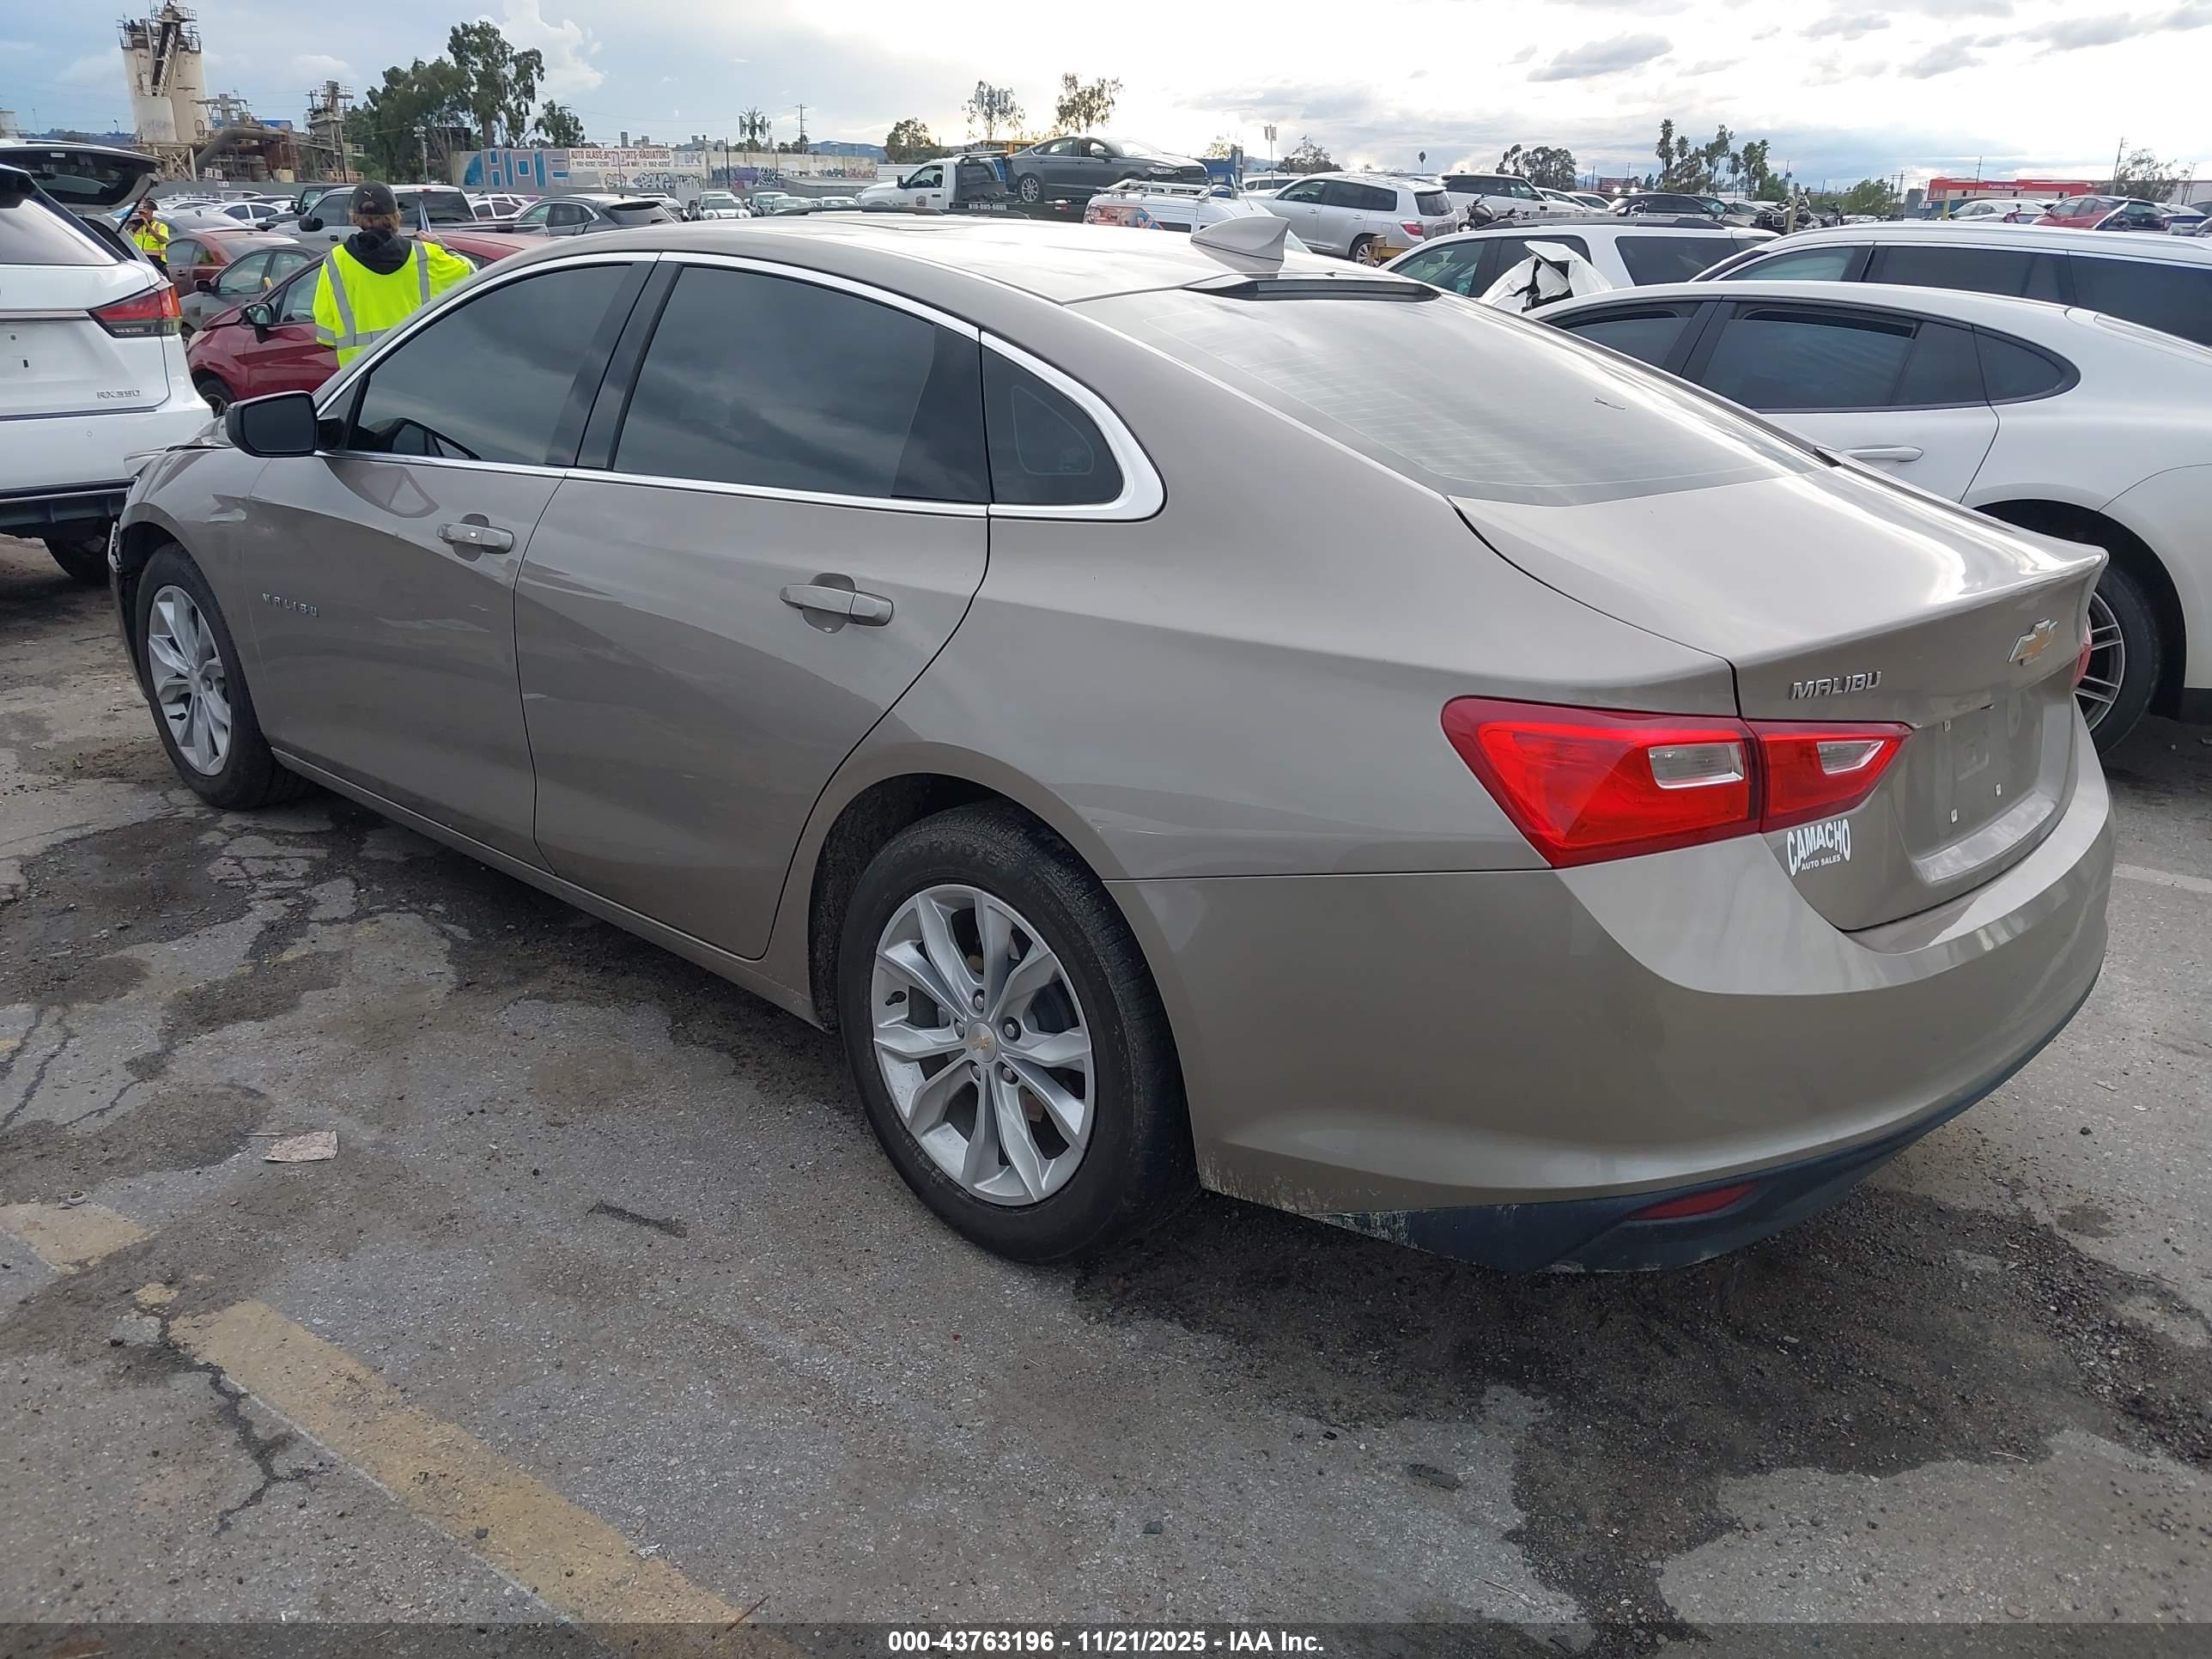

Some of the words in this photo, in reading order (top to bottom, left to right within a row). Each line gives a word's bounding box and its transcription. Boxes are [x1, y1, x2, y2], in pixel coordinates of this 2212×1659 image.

[571, 150, 585, 159] AUTO
[262, 592, 318, 617] MALIBU
[1790, 671, 1881, 700] MALIBU
[1787, 818, 1851, 876] CAMACHO
[1802, 860, 1820, 872] AUTO
[1820, 854, 1841, 866] SALES
